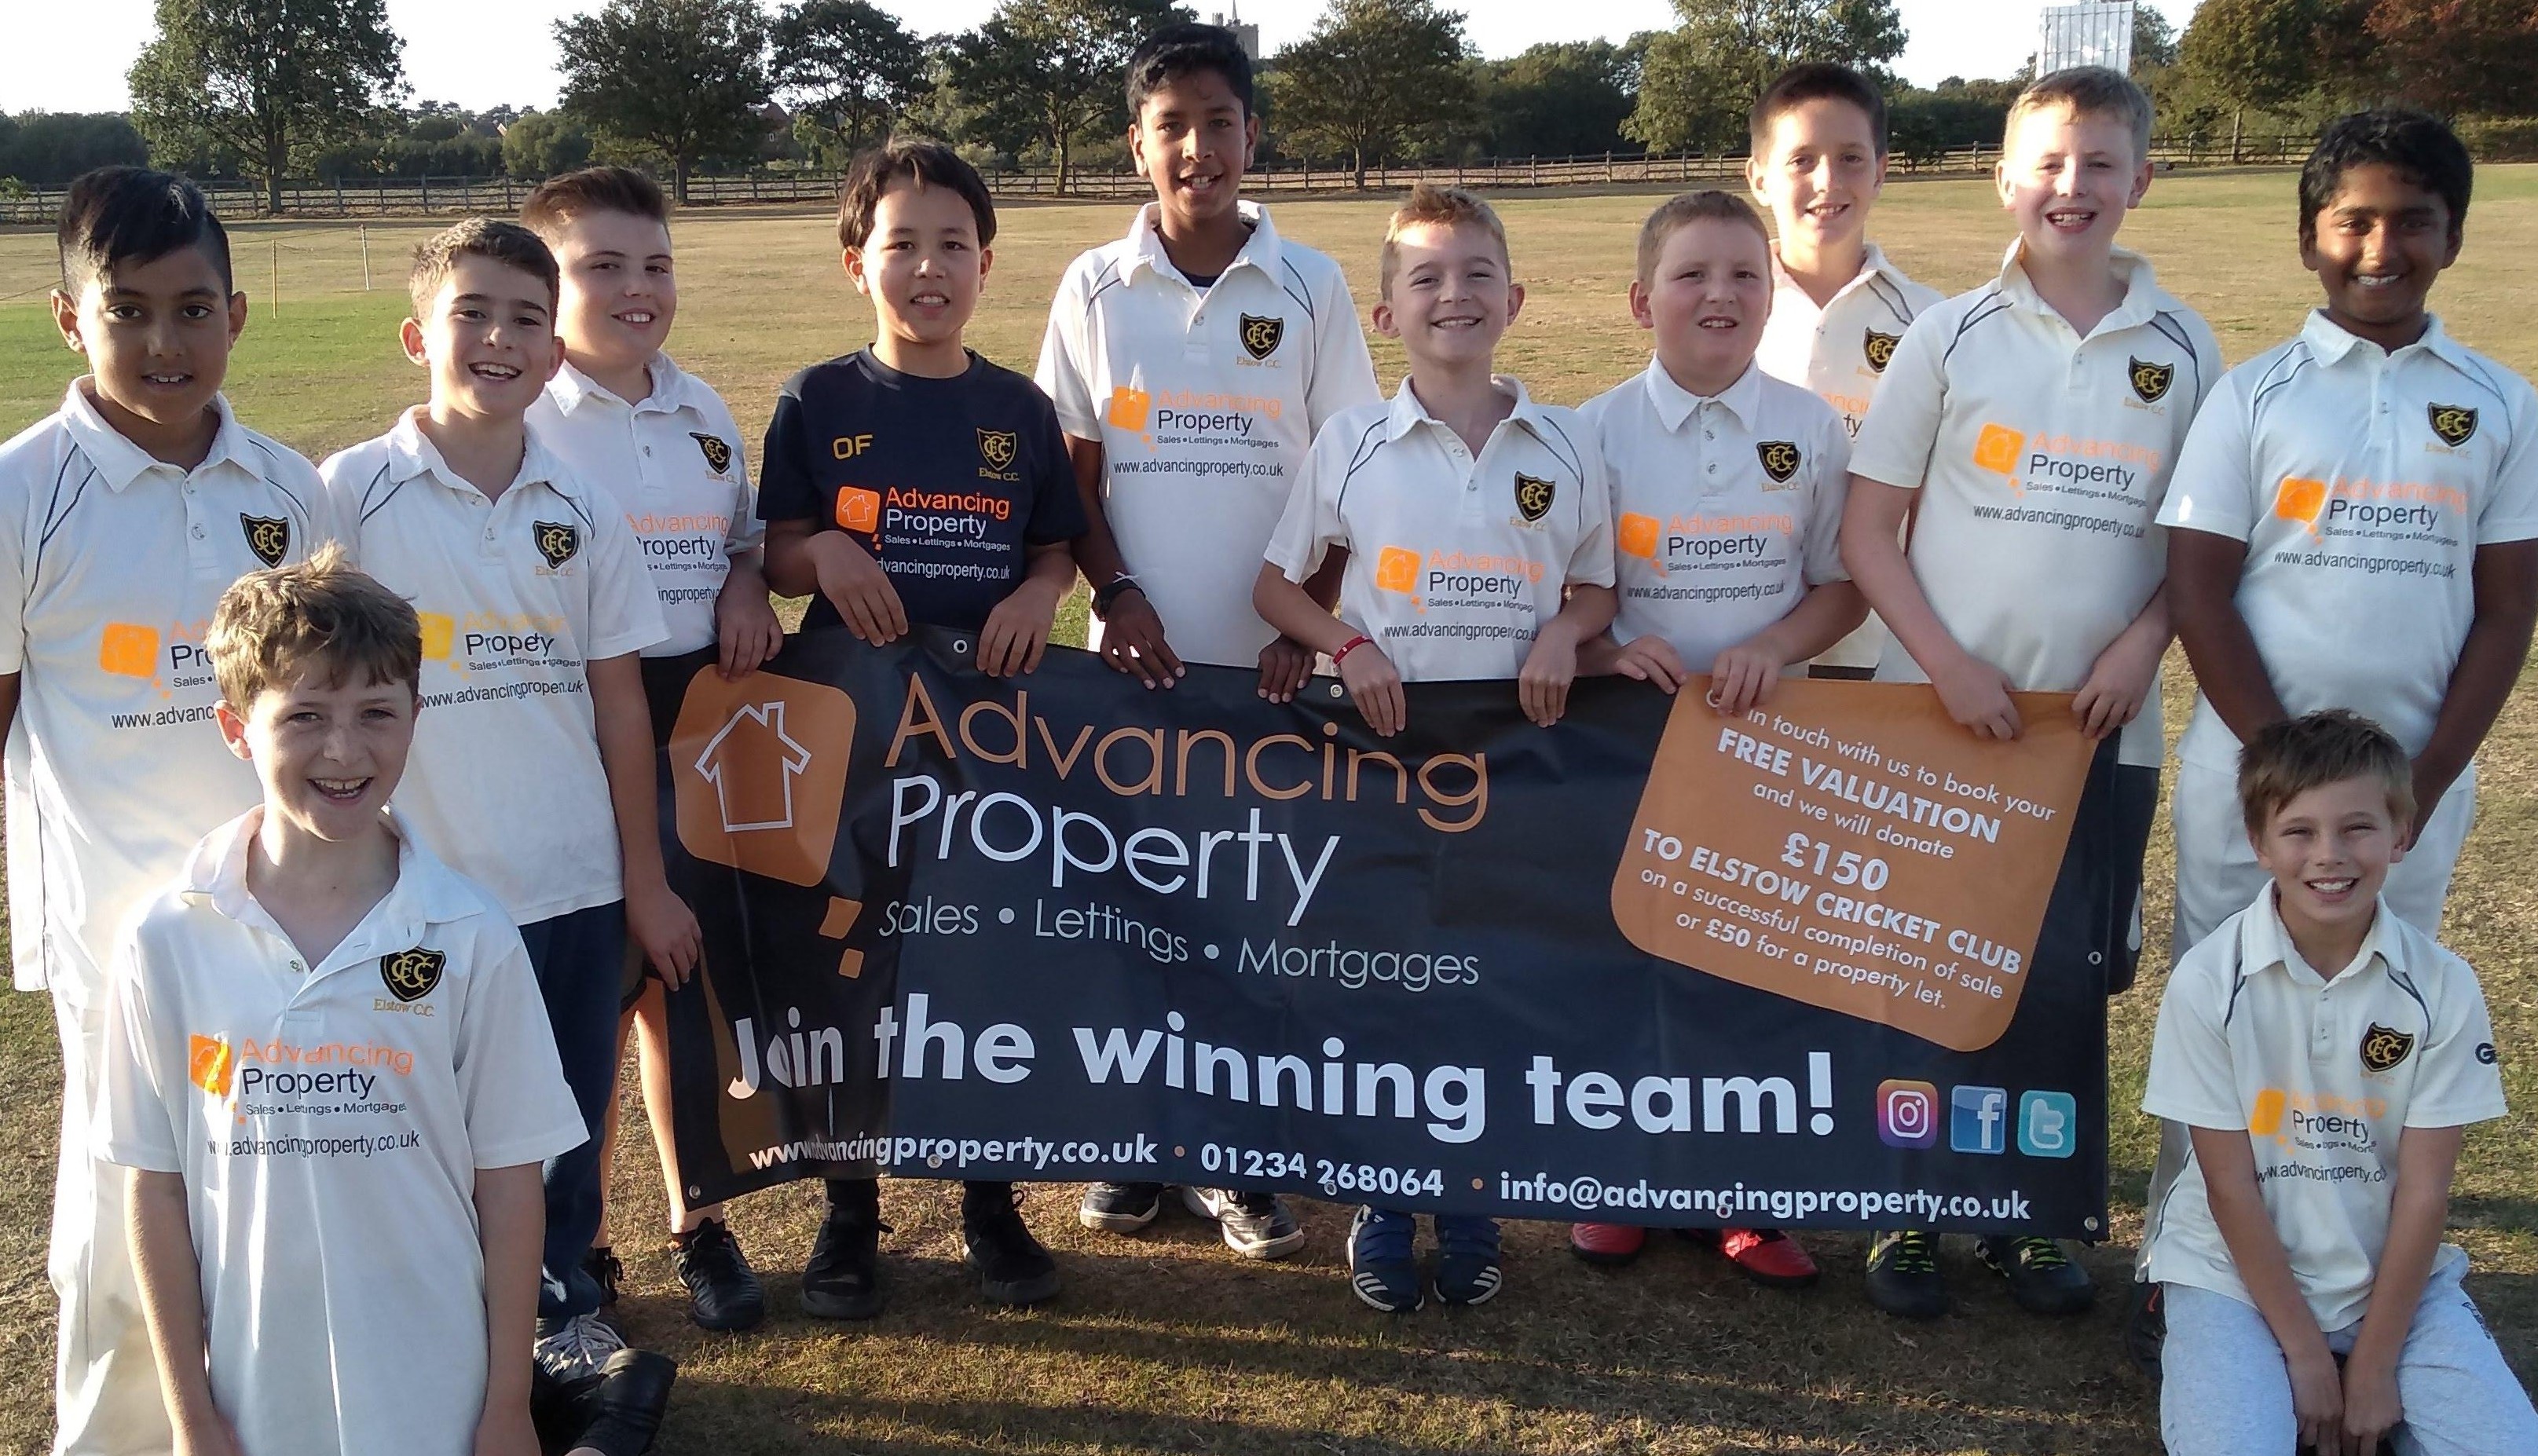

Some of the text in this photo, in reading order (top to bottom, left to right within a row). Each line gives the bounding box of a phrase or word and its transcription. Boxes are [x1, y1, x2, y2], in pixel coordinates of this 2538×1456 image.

[1158, 389, 1282, 420] Advancing
[1158, 409, 1254, 437] Property
[833, 434, 873, 460] OF
[1157, 435, 1279, 448] Sales Lettings Mortgages
[2031, 430, 2161, 473] Advancing
[1113, 458, 1284, 477] www.advancingproperty.co.uk
[2029, 453, 2135, 492] Property
[885, 486, 1010, 521] Advancing
[2027, 481, 2053, 492] Sales
[2061, 485, 2100, 498] Lettings
[2332, 477, 2467, 514] Advancing
[885, 508, 987, 539] Property
[1668, 512, 1793, 536] Advancing
[2328, 499, 2438, 531] Property
[635, 535, 716, 561] roperty
[884, 534, 1011, 551] Sales Lettings Mortgages
[1668, 534, 1767, 559] Property
[2325, 527, 2458, 547] Sales Lettings Morges
[877, 557, 1011, 582] dvancingproperty.co.uk
[1427, 548, 1546, 583] Advancing
[1668, 558, 1786, 571] Sales Lettings Mortgages
[1429, 571, 1522, 599] Property
[1428, 598, 1534, 613] Sales Lettings Mortgag
[468, 660, 498, 671] Sales
[174, 676, 206, 687] Sales
[884, 670, 1489, 832] Advancing
[1772, 713, 1829, 749] touch
[1837, 739, 1881, 767] with
[1887, 757, 1910, 777] us
[1916, 766, 1937, 785] to
[1943, 772, 1999, 804] book
[2005, 794, 2056, 821] your
[1717, 727, 2001, 844] FREE VALUATION
[1753, 781, 1954, 860] and we will donate
[888, 774, 1340, 926] Property
[1780, 831, 1890, 892] £150
[1643, 828, 2022, 975] TO ELSTOW CRICKET CLUB
[879, 896, 1480, 993] Sales Lettings Mortgages
[1641, 869, 2003, 1000] on a successful completion of sale
[1676, 911, 1947, 1009] or £50 for a property let.
[373, 998, 411, 1013] Elstow
[240, 1037, 414, 1076] Advancing
[727, 993, 1835, 1144] Join the winning team!
[242, 1067, 375, 1099] Property
[246, 1103, 275, 1115] Sales
[2293, 1109, 2369, 1144] Proerty
[208, 1129, 420, 1158] w.advancingproperty.co.uk
[749, 1131, 2031, 1224] wwwadvancingproperty.co.uk 01234 268064 info@advancingproperty.co.uk
